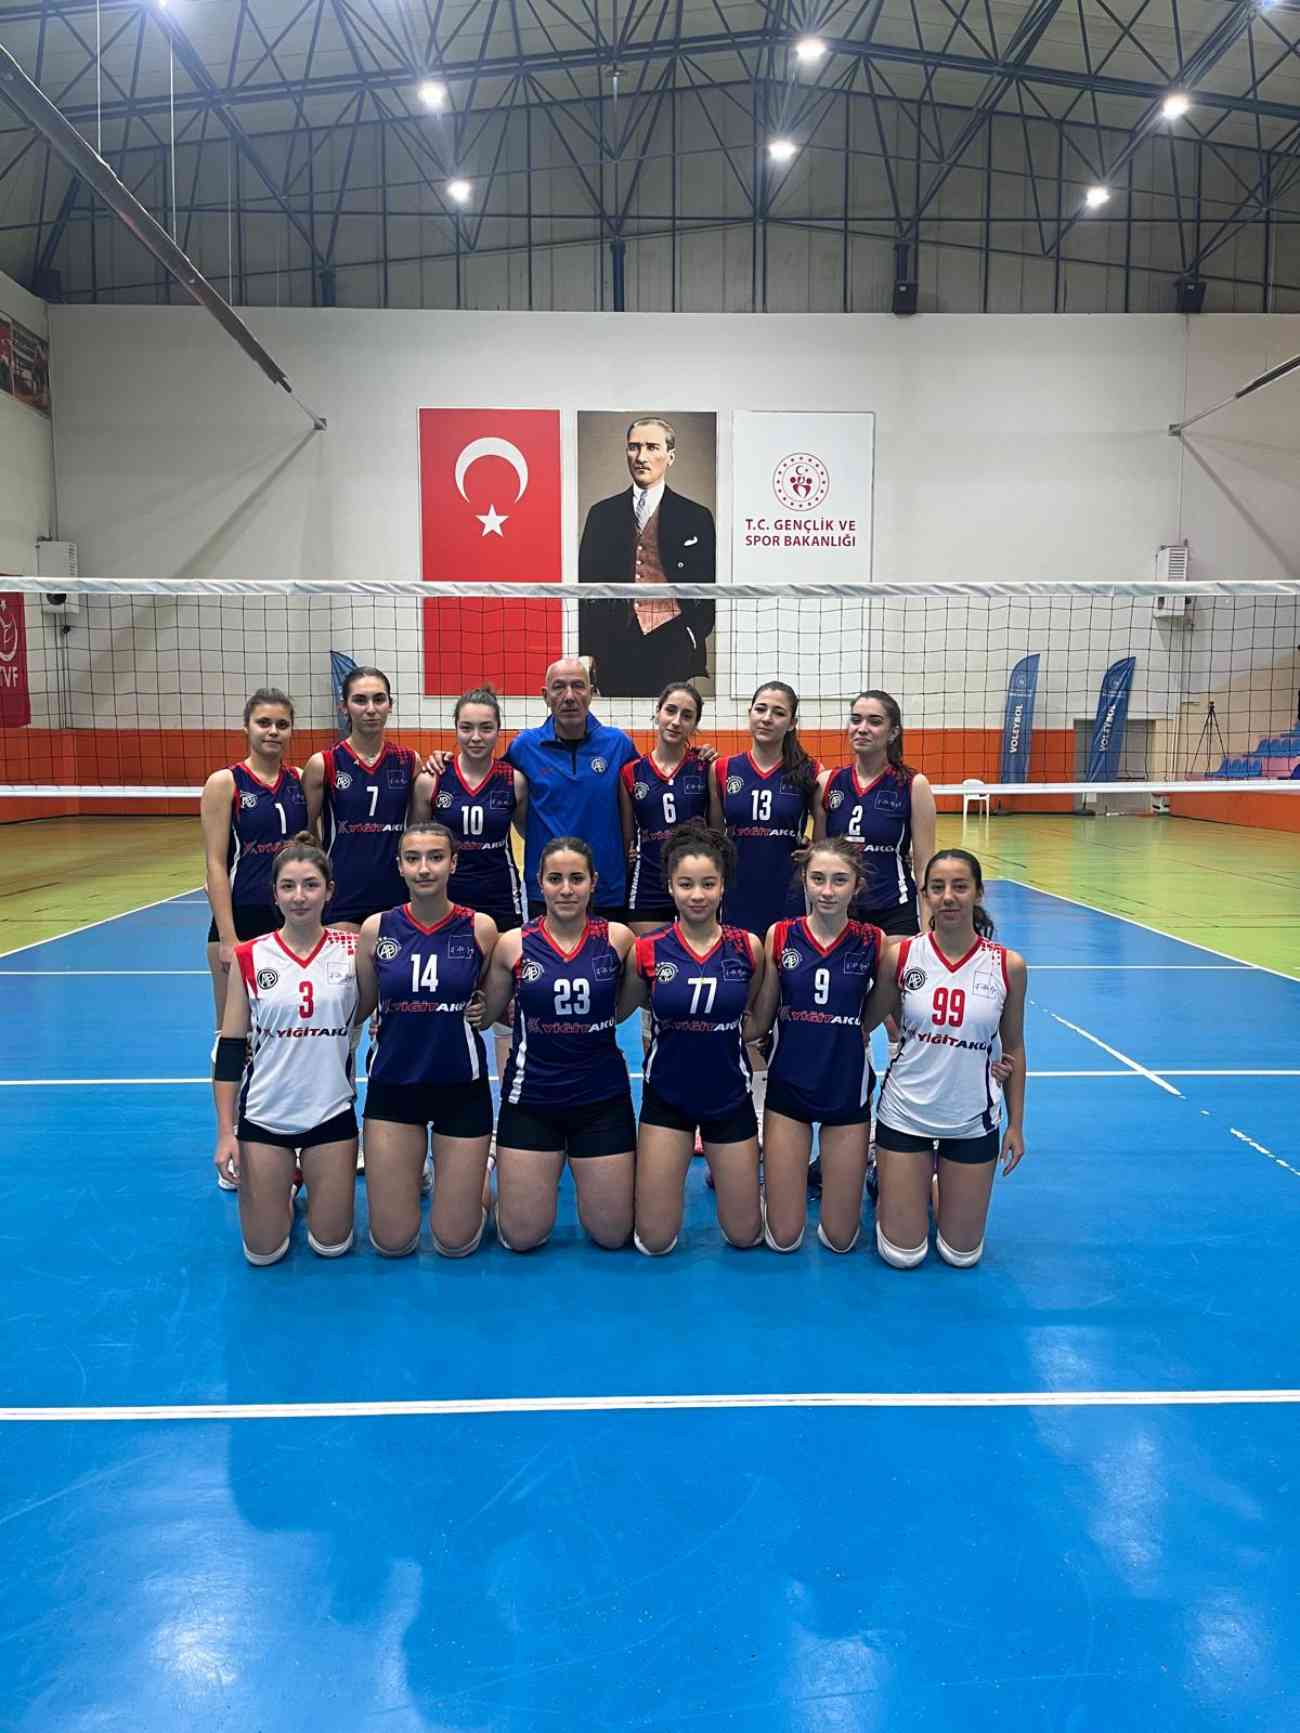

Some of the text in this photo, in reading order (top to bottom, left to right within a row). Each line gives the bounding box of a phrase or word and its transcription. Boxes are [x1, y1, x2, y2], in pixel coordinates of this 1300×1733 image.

[745, 516, 857, 533] T.C. GENÇLİK VE
[745, 534, 856, 547] SPOR BAKANLIĞI
[366, 785, 379, 817] 7
[662, 792, 677, 824] 6
[751, 789, 772, 821] 13
[274, 802, 287, 834] 1
[461, 805, 484, 835] 10
[848, 804, 863, 836] 2
[411, 953, 439, 992] 14
[814, 968, 830, 1005] 9
[299, 980, 314, 1018] 3
[553, 977, 591, 1015] 23
[687, 977, 718, 1014] 77
[931, 987, 965, 1028] 99
